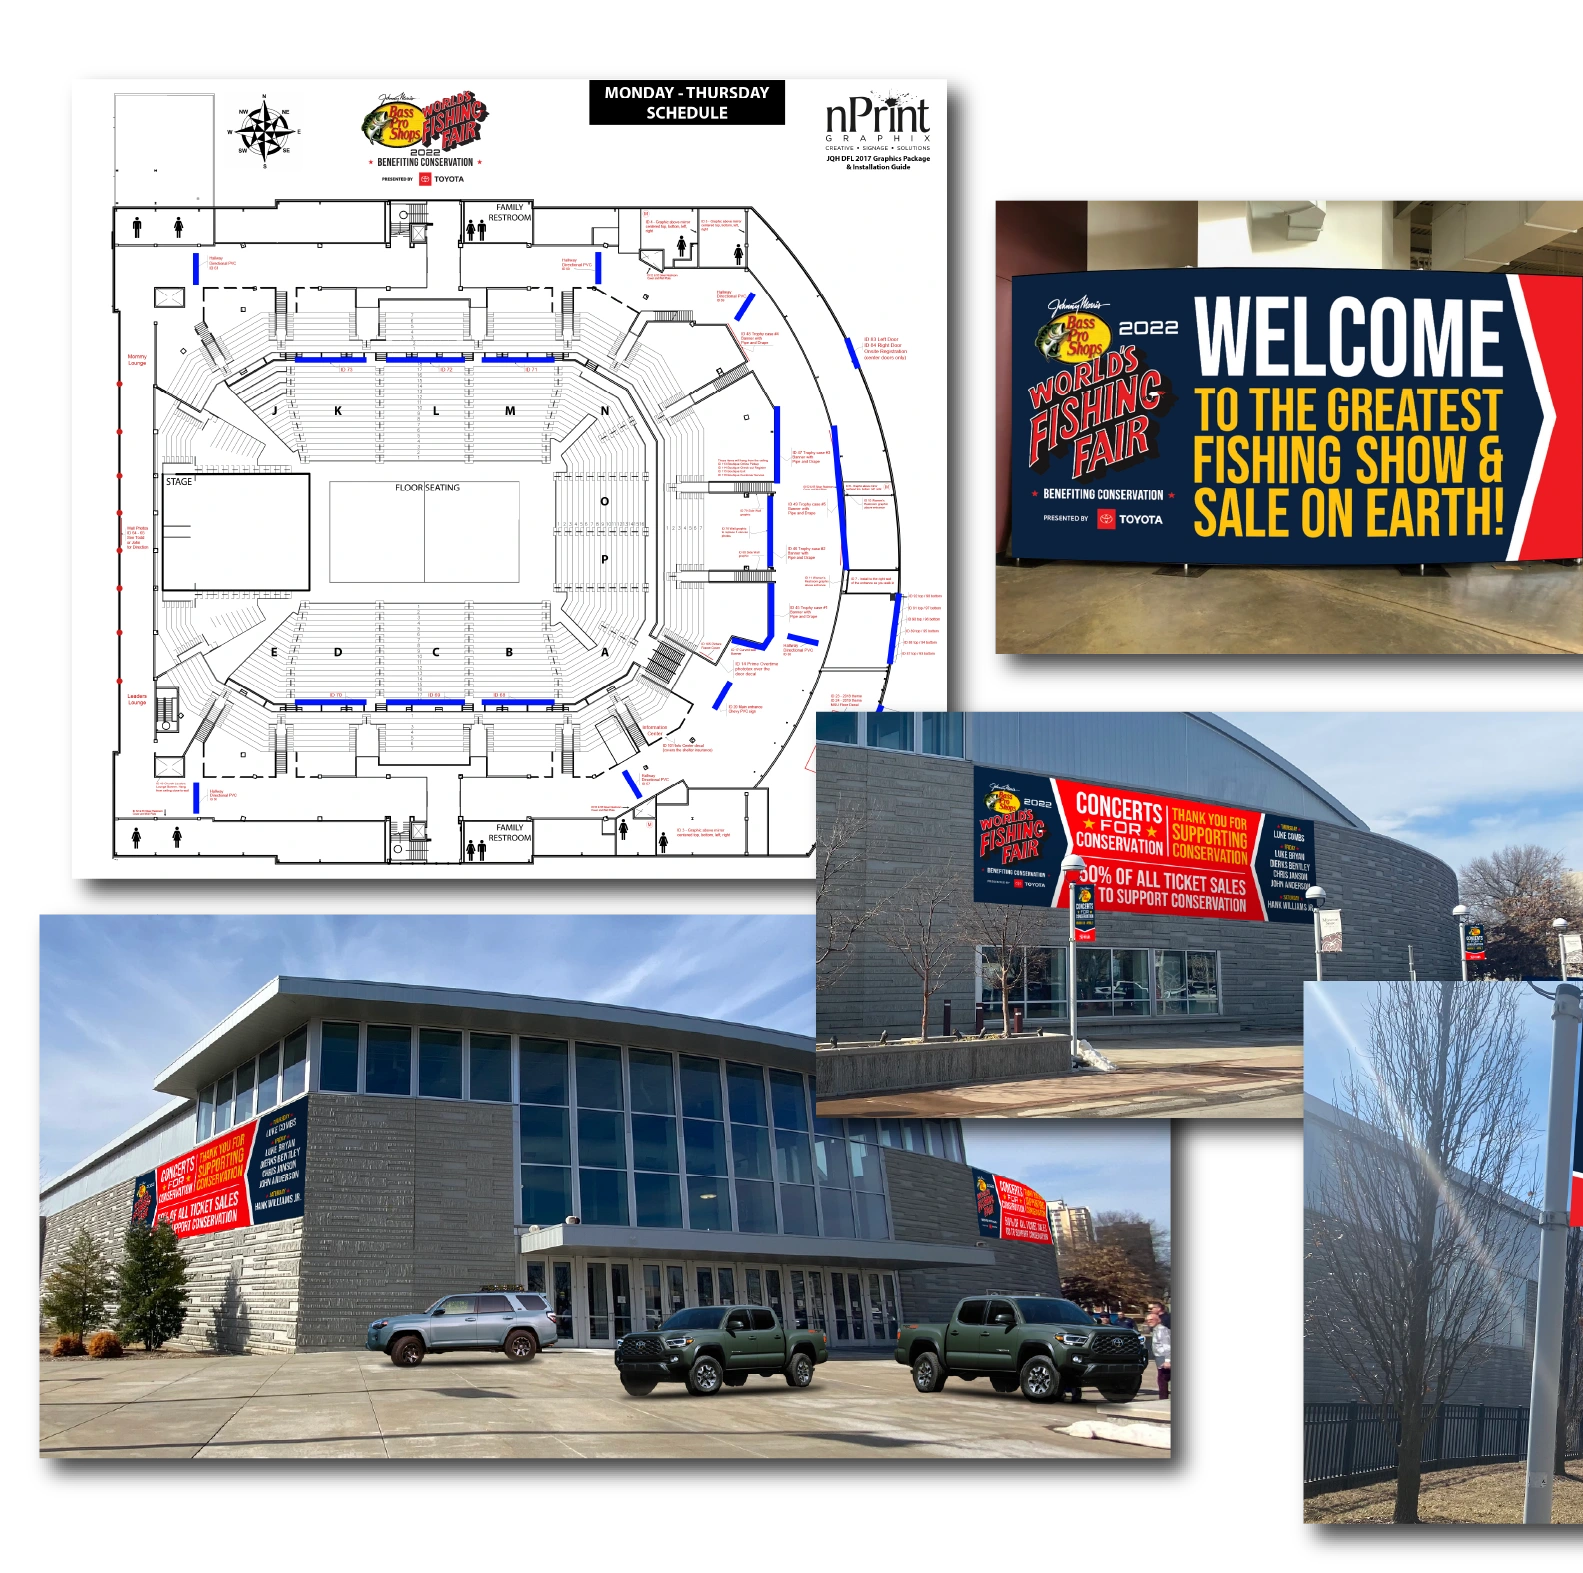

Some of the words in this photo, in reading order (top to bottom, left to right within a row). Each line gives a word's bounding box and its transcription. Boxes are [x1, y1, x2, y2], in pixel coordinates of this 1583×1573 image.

[605, 87, 674, 99] MONDAY
[686, 87, 769, 99] THURSDAY
[647, 107, 728, 119] SCHEDULE
[826, 96, 931, 133] nPrint
[377, 158, 419, 167] BENEFITING
[421, 158, 473, 167] CONSERVATION
[873, 156, 901, 164] Graphics
[903, 156, 931, 164] Package
[1066, 316, 1096, 330] Bass
[1119, 320, 1179, 335] 2022
[1067, 329, 1089, 342] Pro
[1194, 296, 1504, 378] WELCOME
[1066, 340, 1103, 358] Shops
[1030, 345, 1137, 397] WORLD'S
[334, 406, 342, 416] K
[1194, 387, 1239, 432] TO
[1249, 387, 1317, 432] THE
[1327, 387, 1504, 432] GREATEST
[1028, 369, 1164, 469] FISHING
[1072, 414, 1149, 480] FAIR
[1194, 435, 1341, 483] FISHING
[1357, 436, 1468, 484] SHOW
[1479, 435, 1504, 483] &
[166, 478, 192, 486] STAGE
[395, 484, 423, 492] FLOOR
[425, 484, 460, 492] SEATING
[1043, 488, 1095, 501] BENEFITING
[1097, 488, 1164, 501] CONSERVATION
[1119, 514, 1163, 525] TOYOTA
[1194, 487, 1288, 538] SALE
[1302, 488, 1353, 537] ON
[1367, 486, 1504, 537] EARTH!
[1172, 823, 1247, 849] SUPPORTING
[1173, 843, 1248, 865] CONSERVATION
[198, 1149, 244, 1178] SUPPORTING
